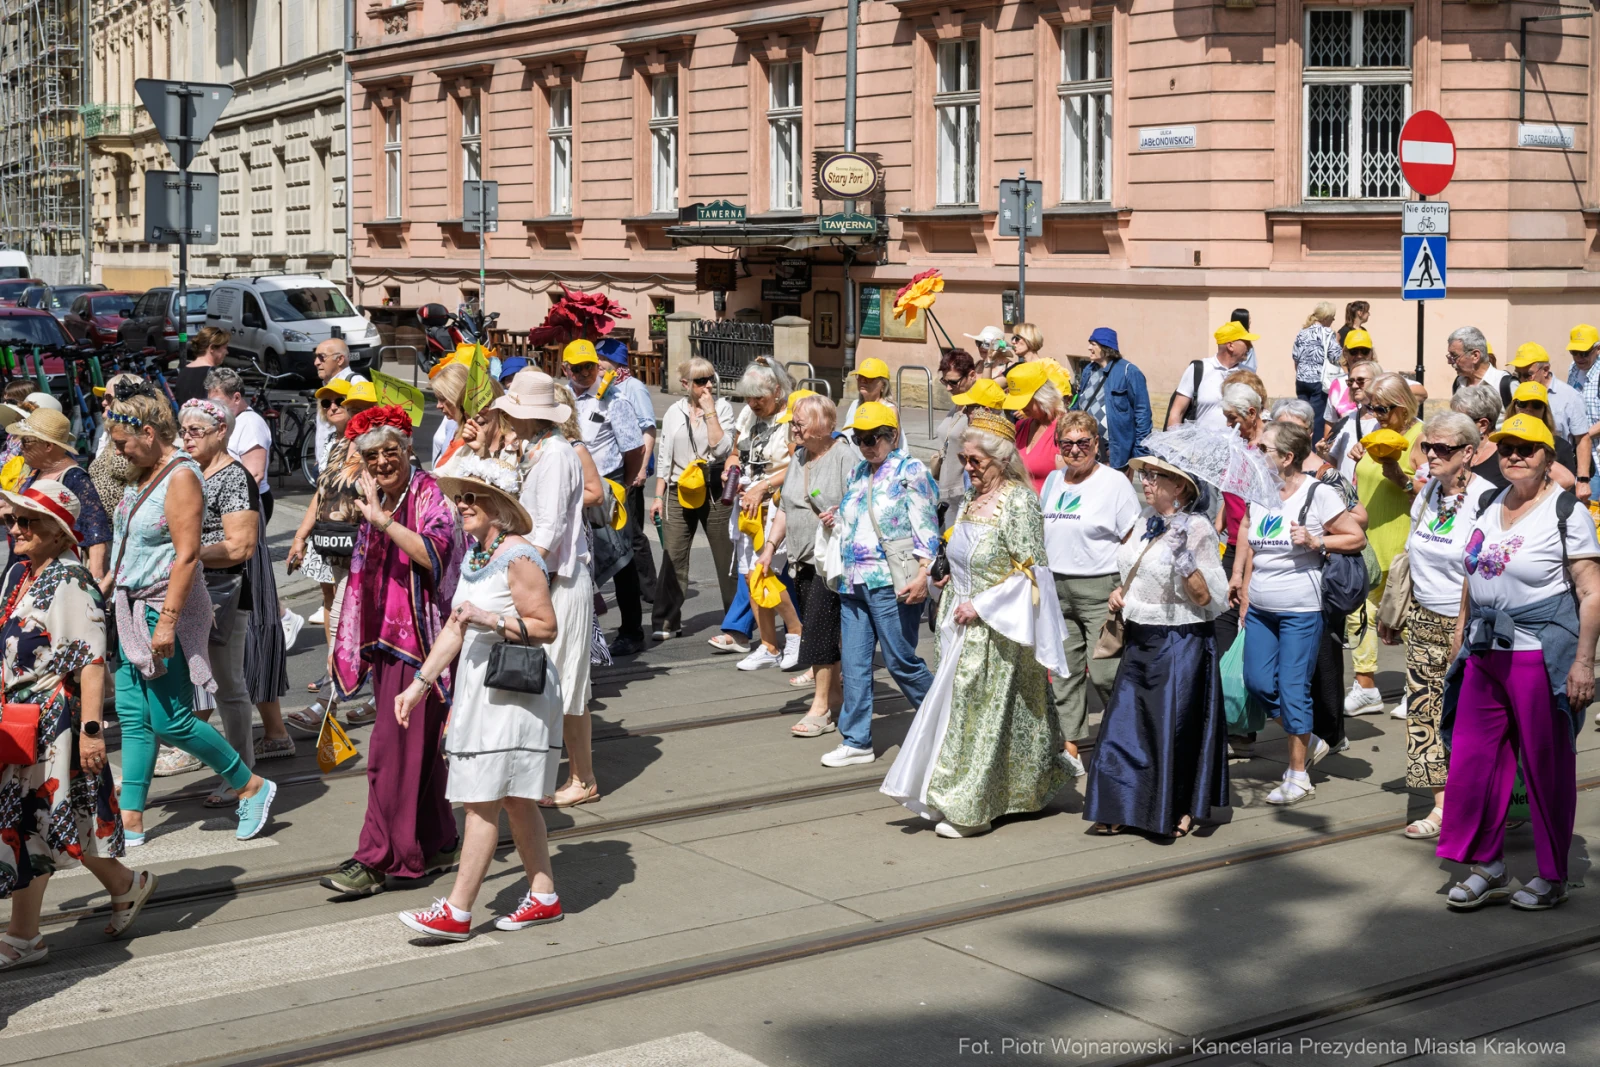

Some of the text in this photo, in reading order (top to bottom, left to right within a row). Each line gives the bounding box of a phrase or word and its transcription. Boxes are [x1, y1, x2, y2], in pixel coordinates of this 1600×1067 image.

[1141, 136, 1194, 147] JABŁONOWSKICH
[828, 171, 864, 187] Stary Port
[700, 210, 743, 218] TAWERNA
[1406, 204, 1448, 216] Nie dotyczy
[823, 220, 873, 229] TAWERNA
